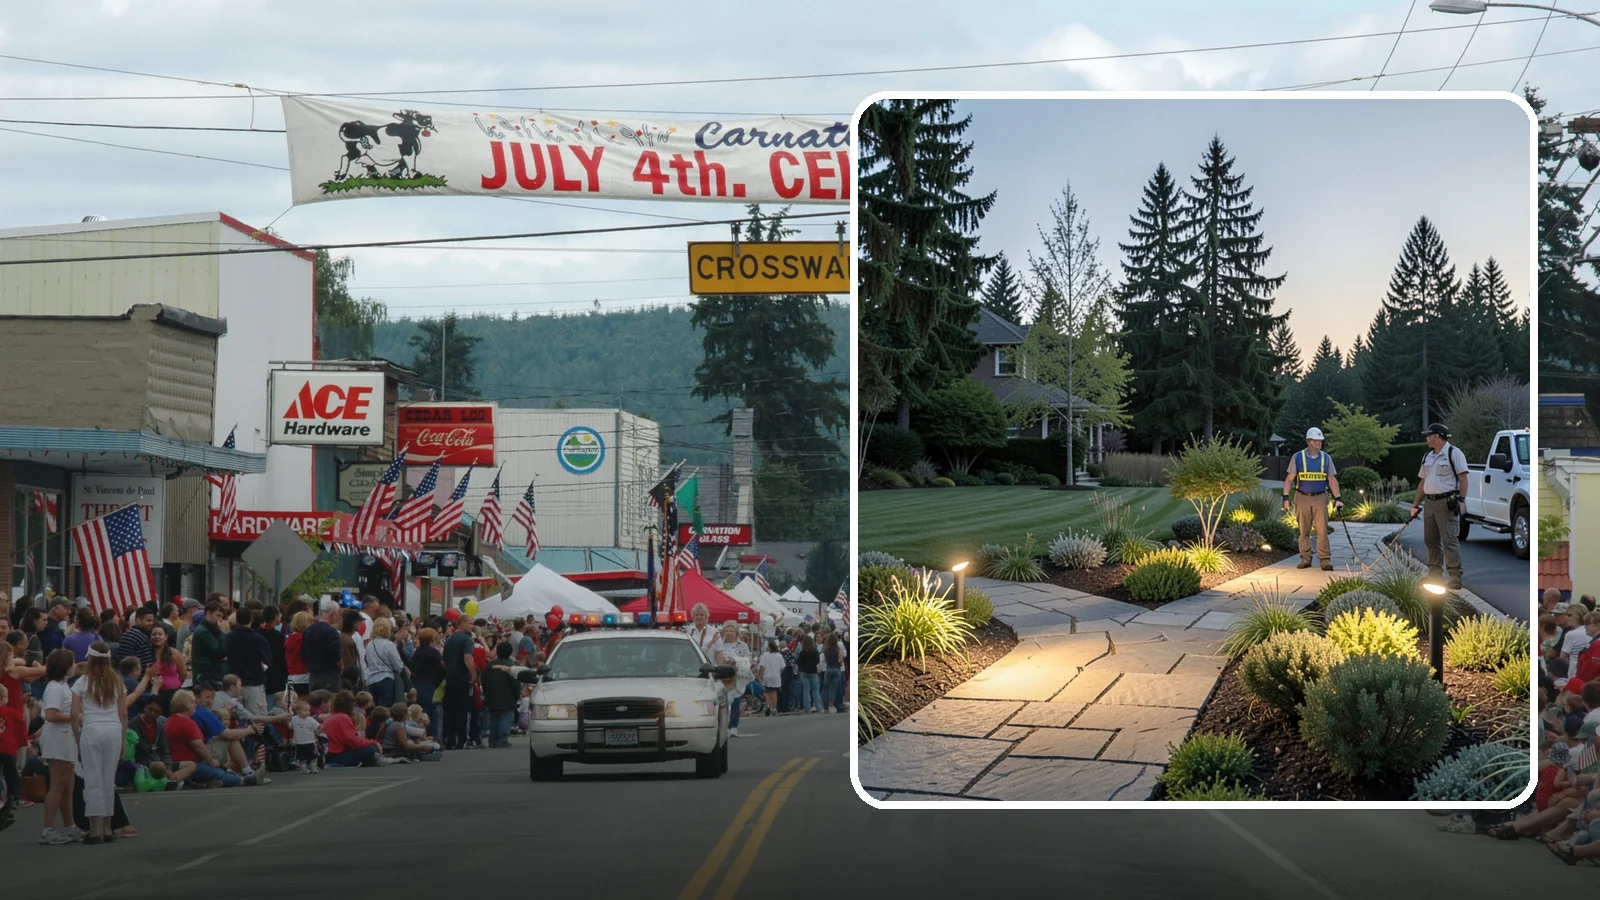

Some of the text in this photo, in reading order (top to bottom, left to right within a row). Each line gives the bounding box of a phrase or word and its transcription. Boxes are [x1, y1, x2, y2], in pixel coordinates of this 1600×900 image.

[481, 141, 605, 192] JULY
[632, 150, 747, 198] 4th.
[697, 254, 850, 280] CROSSWA
[283, 380, 374, 419] ACE
[406, 409, 452, 422] CEDAR
[283, 421, 370, 436] Hardware
[416, 428, 477, 447] Coca-Cola
[95, 485, 124, 494] Vincent
[126, 486, 136, 495] de
[137, 486, 155, 495] Paul
[213, 516, 330, 535] HARDARE
[688, 526, 741, 535] CRNATION
[699, 535, 730, 543] GLASS
